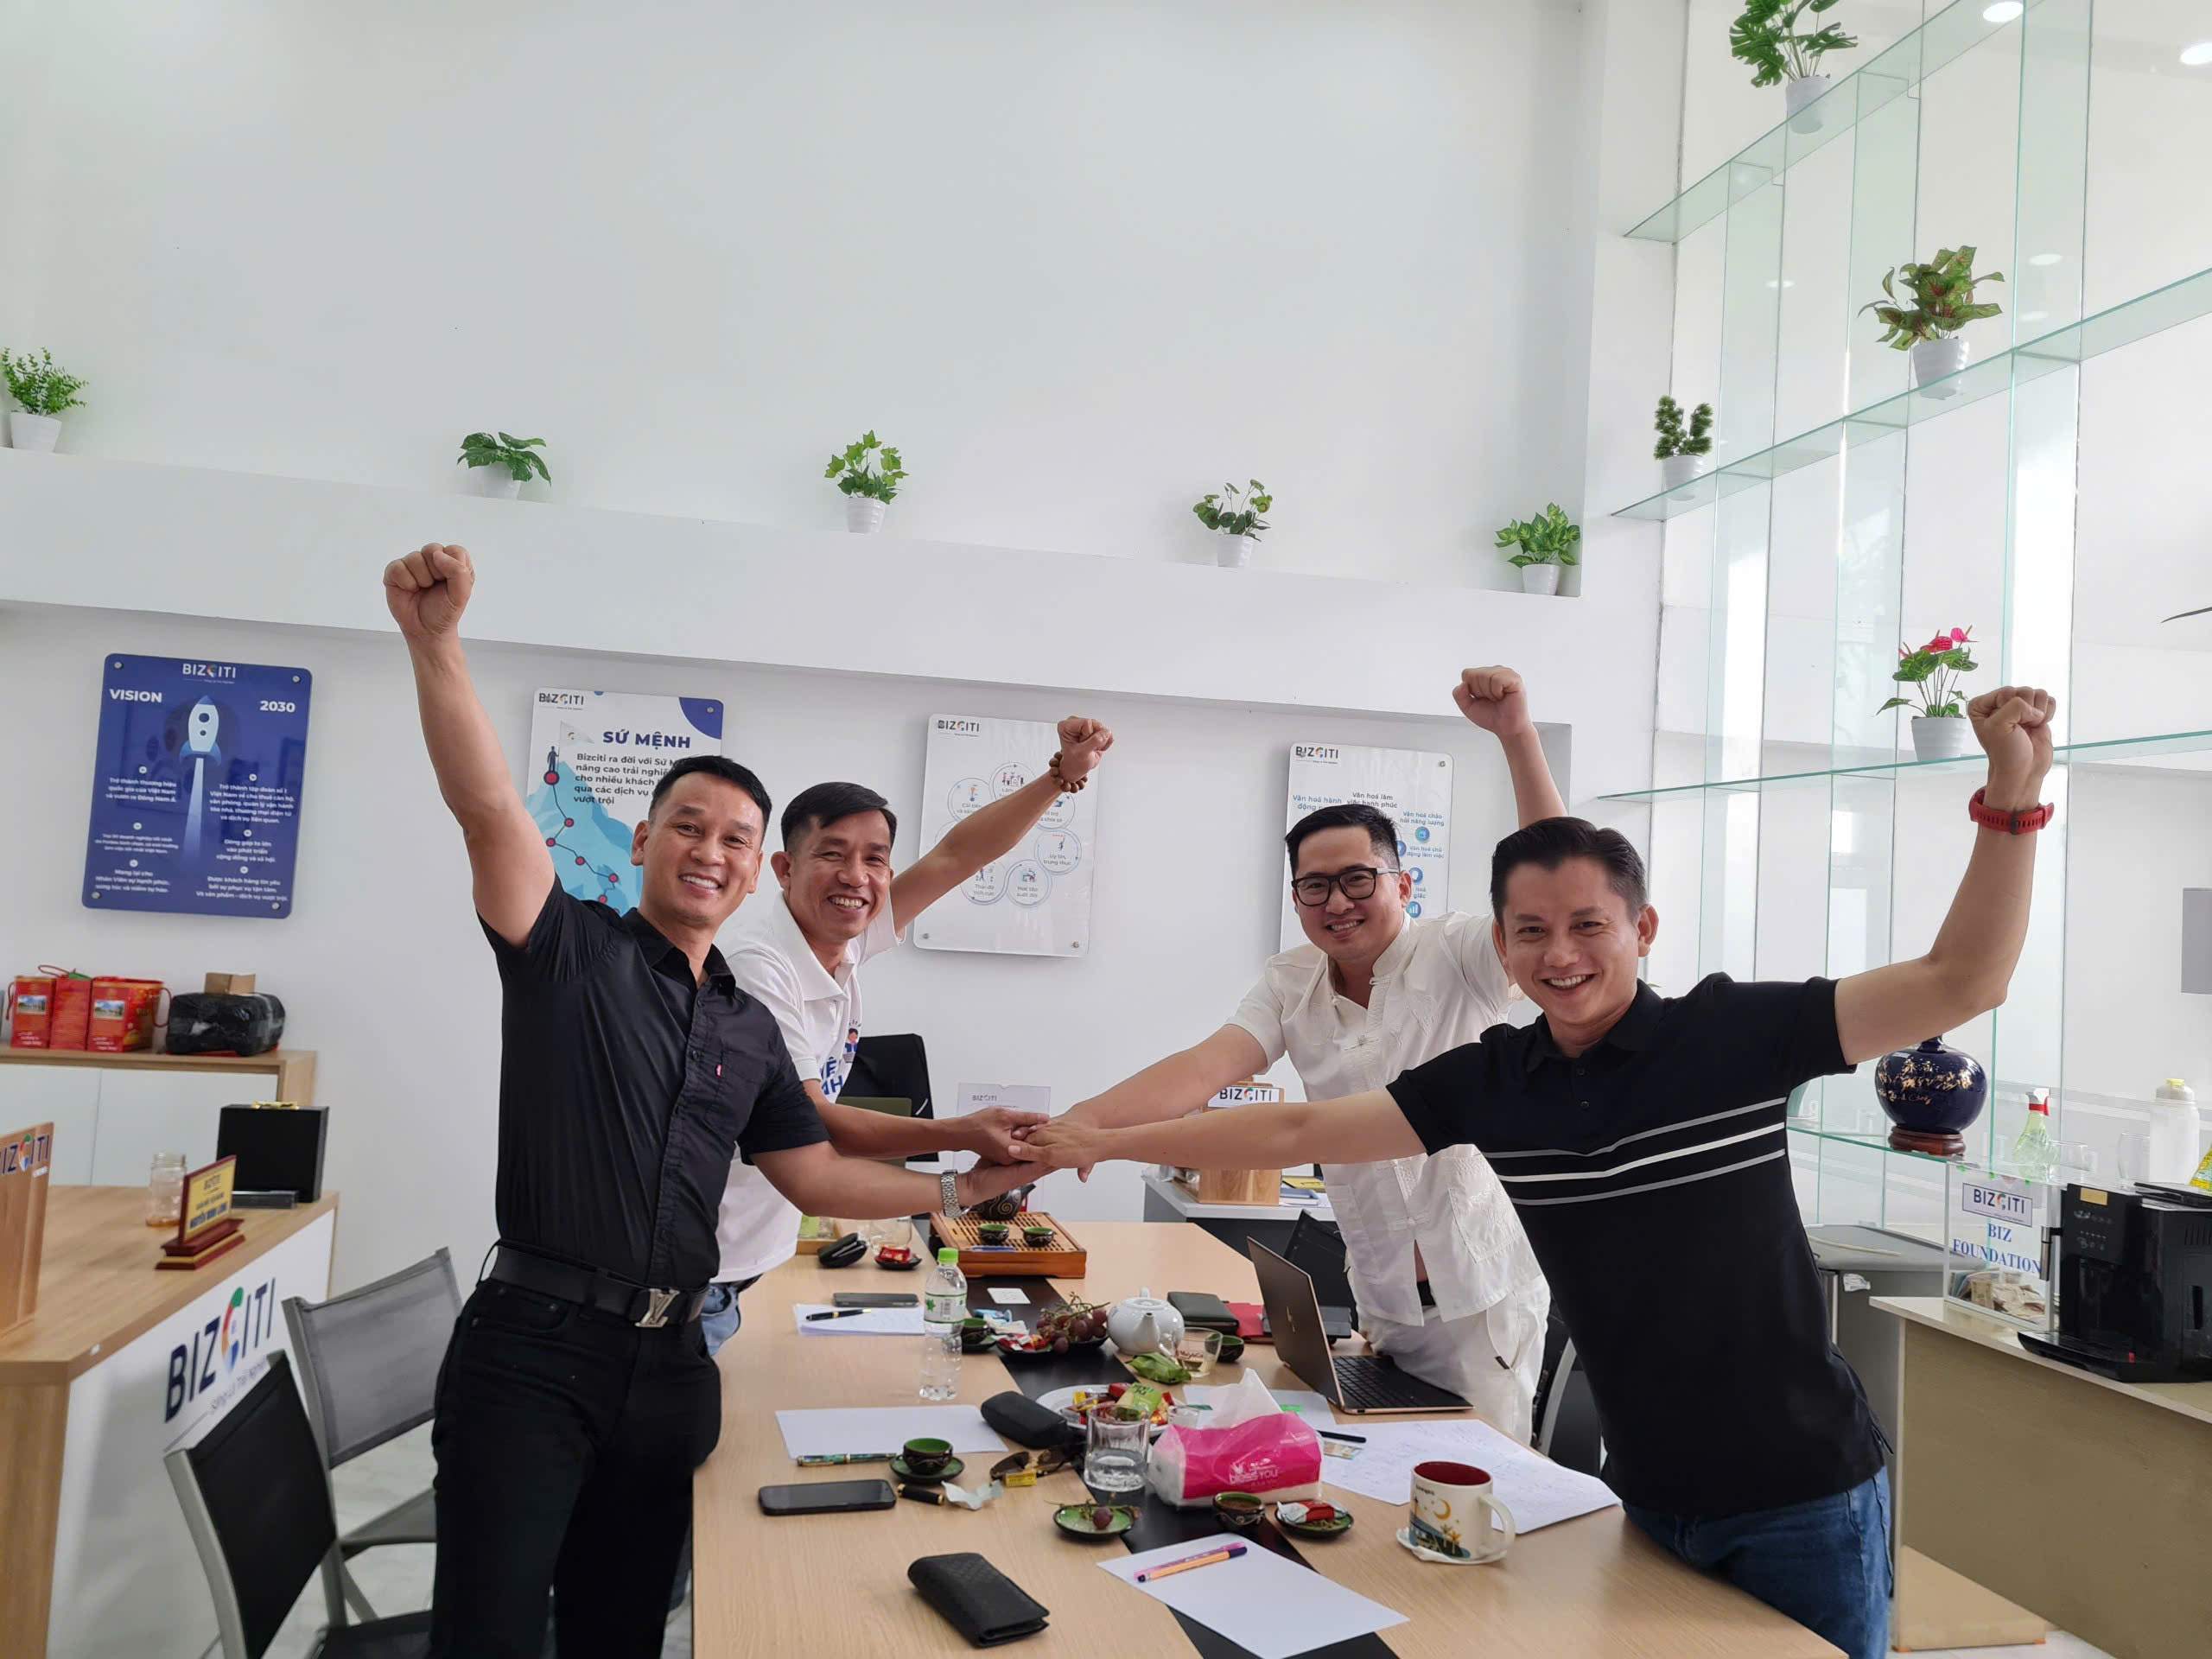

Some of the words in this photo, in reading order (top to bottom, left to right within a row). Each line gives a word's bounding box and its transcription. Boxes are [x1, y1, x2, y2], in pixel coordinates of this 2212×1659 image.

[182, 664, 236, 678] BIZCITI
[109, 690, 162, 702] VISION
[260, 701, 296, 712] 2030
[539, 693, 584, 705] BIZCITI
[938, 720, 979, 732] BIZCITI
[603, 729, 629, 744] SỨ
[636, 731, 690, 750] MỆNH
[577, 753, 606, 762] Bizciti
[1296, 747, 1338, 759] BIZCITI
[575, 765, 601, 773] nâng
[614, 787, 634, 796] dịch
[598, 797, 614, 805] trội
[1220, 1087, 1272, 1101] BIZCITI
[0, 1134, 50, 1173] IZCITI
[1974, 1189, 2024, 1214] BIZCITI
[1988, 1224, 2012, 1243] BIZ
[1953, 1238, 2042, 1273] FOUNDATION
[164, 1277, 276, 1424] BIZCITI
